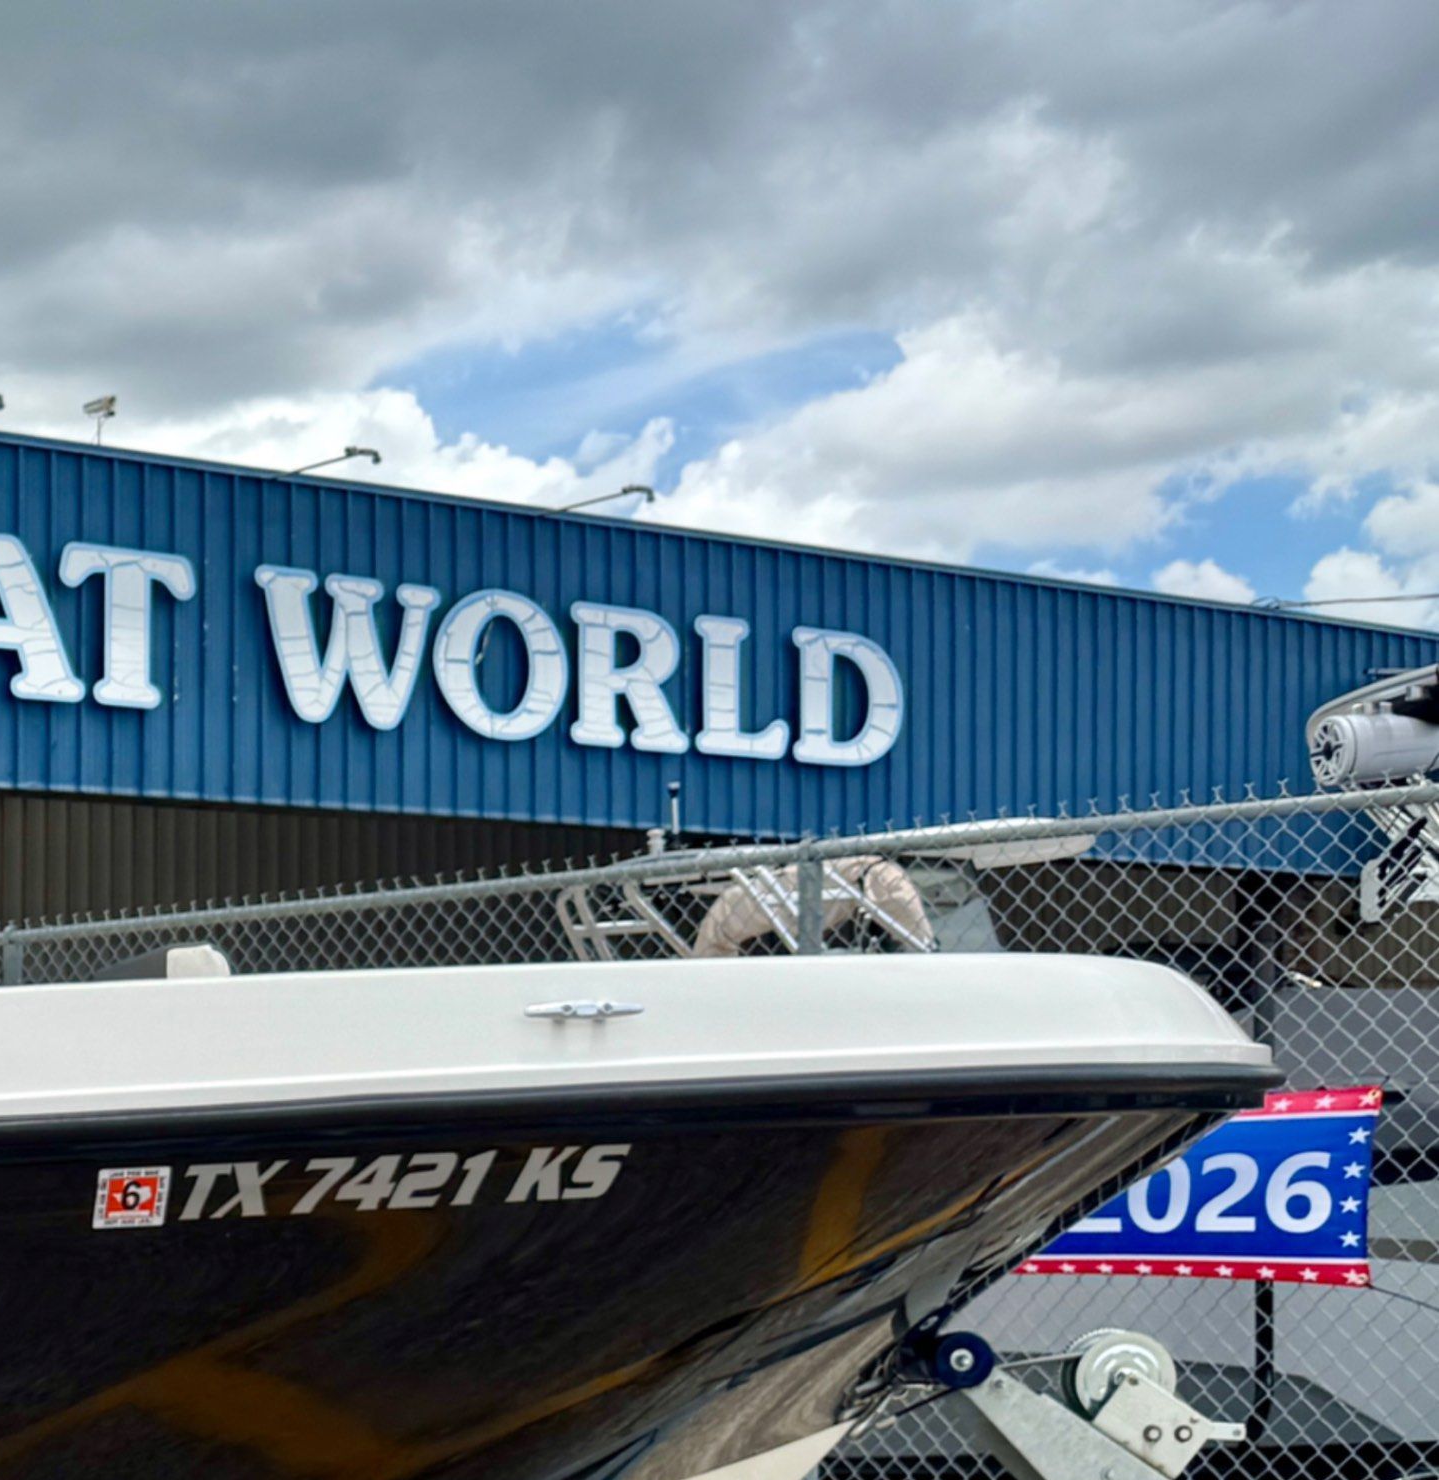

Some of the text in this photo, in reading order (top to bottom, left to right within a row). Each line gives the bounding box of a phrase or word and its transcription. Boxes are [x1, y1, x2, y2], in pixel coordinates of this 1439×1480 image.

[254, 563, 904, 766] WORLD
[121, 1181, 141, 1211] 6
[178, 1159, 290, 1221] TX
[289, 1149, 499, 1215] 7421
[504, 1143, 632, 1203] KS
